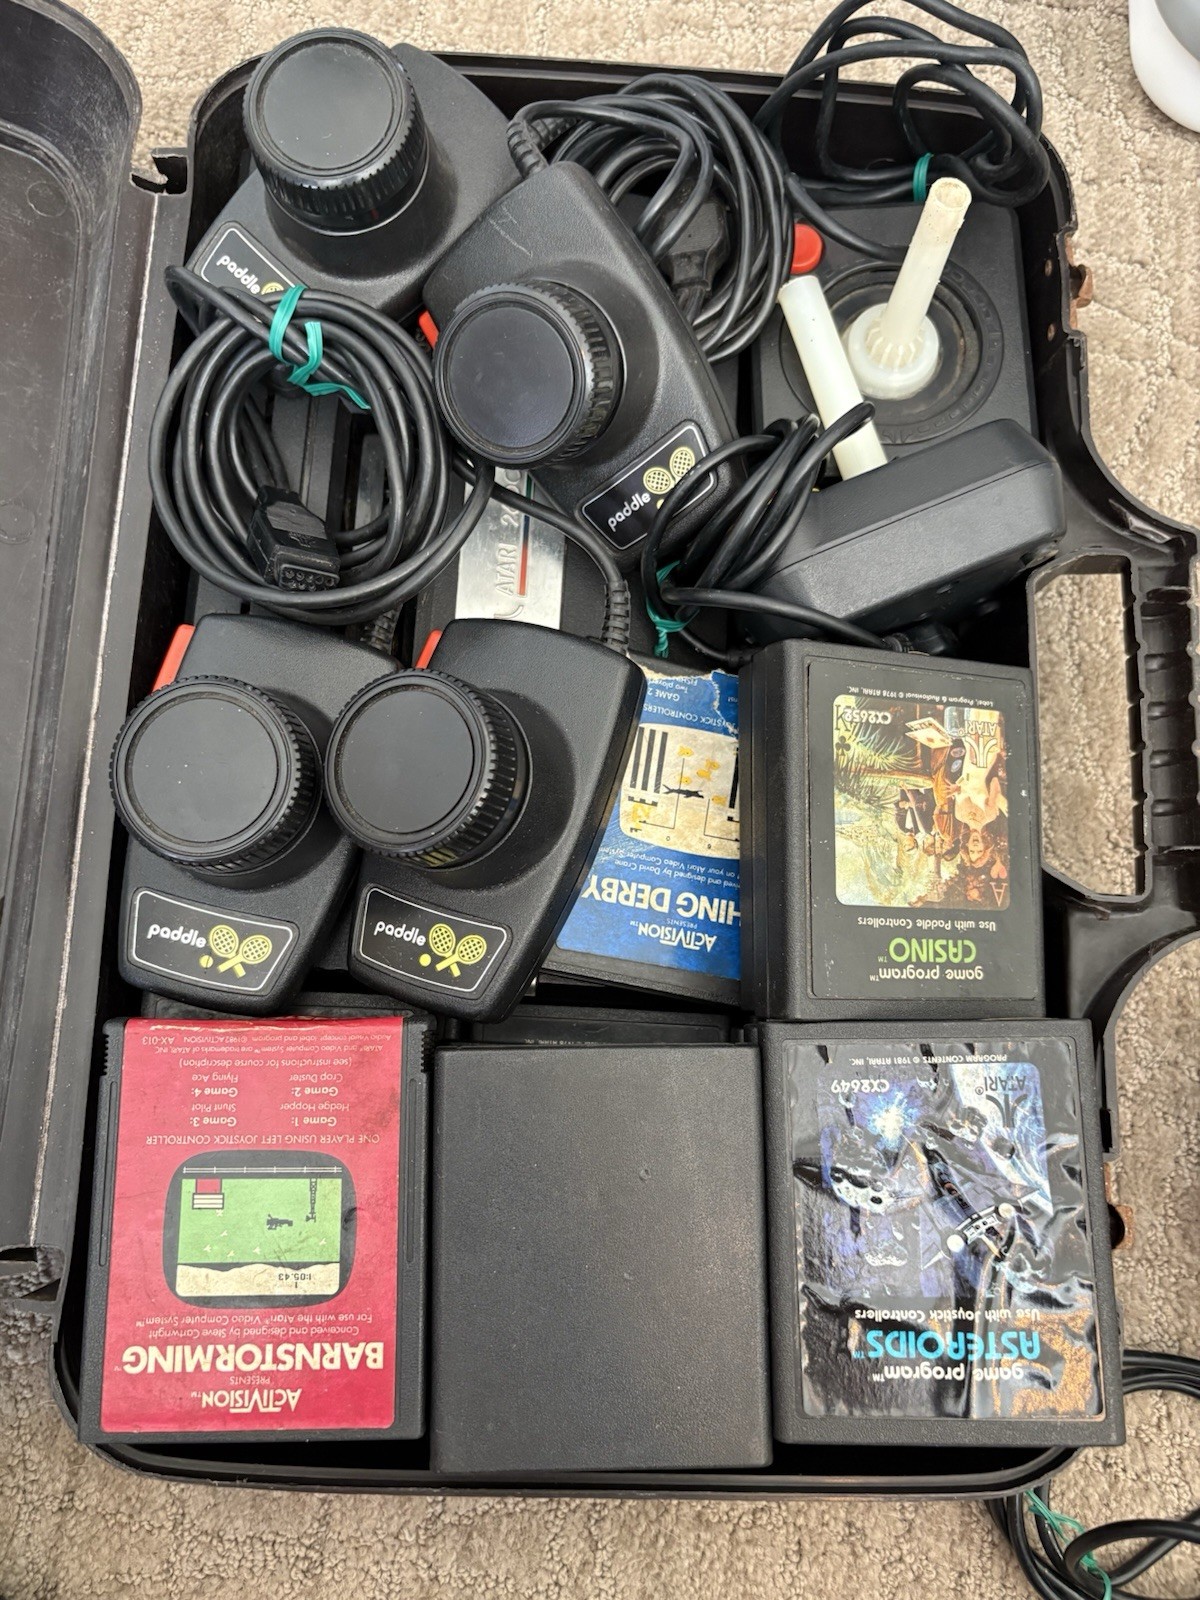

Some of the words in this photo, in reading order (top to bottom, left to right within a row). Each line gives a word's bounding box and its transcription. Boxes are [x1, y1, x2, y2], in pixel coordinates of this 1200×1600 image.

[216, 255, 260, 294] paddle
[608, 492, 651, 532] paddle
[495, 542, 518, 596] ATARI
[655, 689, 680, 701] GAME
[906, 692, 940, 702] Audiovisual
[948, 696, 974, 706] Program
[644, 703, 698, 722] CONTROLLERS
[844, 709, 891, 725] CX2652
[625, 852, 662, 865] Computer
[614, 860, 637, 870] Crane
[664, 859, 685, 869] Video
[687, 864, 706, 873] Atari
[639, 864, 660, 875] David
[663, 868, 672, 879] by
[708, 868, 724, 876] your
[674, 871, 706, 884] designed
[708, 878, 721, 887] and
[582, 874, 671, 913] DERBY
[666, 918, 698, 929] PRESENTS
[857, 917, 912, 929] Controllers
[916, 918, 951, 930] Paddle
[954, 920, 975, 931] with
[978, 921, 996, 931] Use
[146, 923, 207, 949] paddle
[374, 920, 426, 946] paddle
[944, 966, 984, 980] game
[142, 1036, 175, 1045] AX-013
[286, 1045, 319, 1053] Computer
[179, 1058, 232, 1068] description)
[266, 1059, 279, 1068] for
[281, 1059, 330, 1067] instructions
[333, 1057, 352, 1066] (see
[866, 1057, 891, 1065] ATARI,
[922, 1055, 963, 1063] CONTENTS
[192, 1074, 210, 1082] Ace
[212, 1072, 238, 1082] Flying
[289, 1073, 317, 1082] Duster
[320, 1072, 343, 1082] Crop
[305, 1086, 338, 1096] Game
[830, 1079, 890, 1093] CX2649
[191, 1088, 201, 1097] 4:
[204, 1087, 238, 1097] Game
[291, 1087, 301, 1097] 2:
[192, 1103, 212, 1112] Pilot
[214, 1103, 236, 1112] Stunt
[280, 1101, 315, 1112] Hopper
[318, 1101, 350, 1112] Hedge
[190, 1117, 200, 1127] 3:
[203, 1117, 237, 1127] Game
[291, 1117, 299, 1126] 1:
[303, 1116, 337, 1126] Game
[146, 1135, 210, 1145] CONTROLLER
[214, 1135, 258, 1144] JOYSTICK
[261, 1135, 282, 1144] LEFT
[285, 1135, 316, 1143] USING
[320, 1134, 355, 1143] PLAYER
[358, 1134, 380, 1143] ONE
[298, 1314, 312, 1323] the
[315, 1314, 336, 1323] with
[357, 1313, 372, 1323] For
[854, 1309, 925, 1322] Controllers
[930, 1307, 981, 1322] Joystick
[985, 1309, 1011, 1322] with
[1016, 1308, 1039, 1320] Use
[182, 1314, 229, 1325] Computer
[232, 1315, 261, 1324] Video
[148, 1327, 200, 1339] Cartwright
[202, 1328, 226, 1338] Steve
[229, 1326, 240, 1337] by
[243, 1326, 287, 1337] designed
[289, 1327, 308, 1336] and
[310, 1326, 359, 1336] Conceived
[972, 1362, 1023, 1381] game
[229, 1376, 270, 1385] PRESENTS
